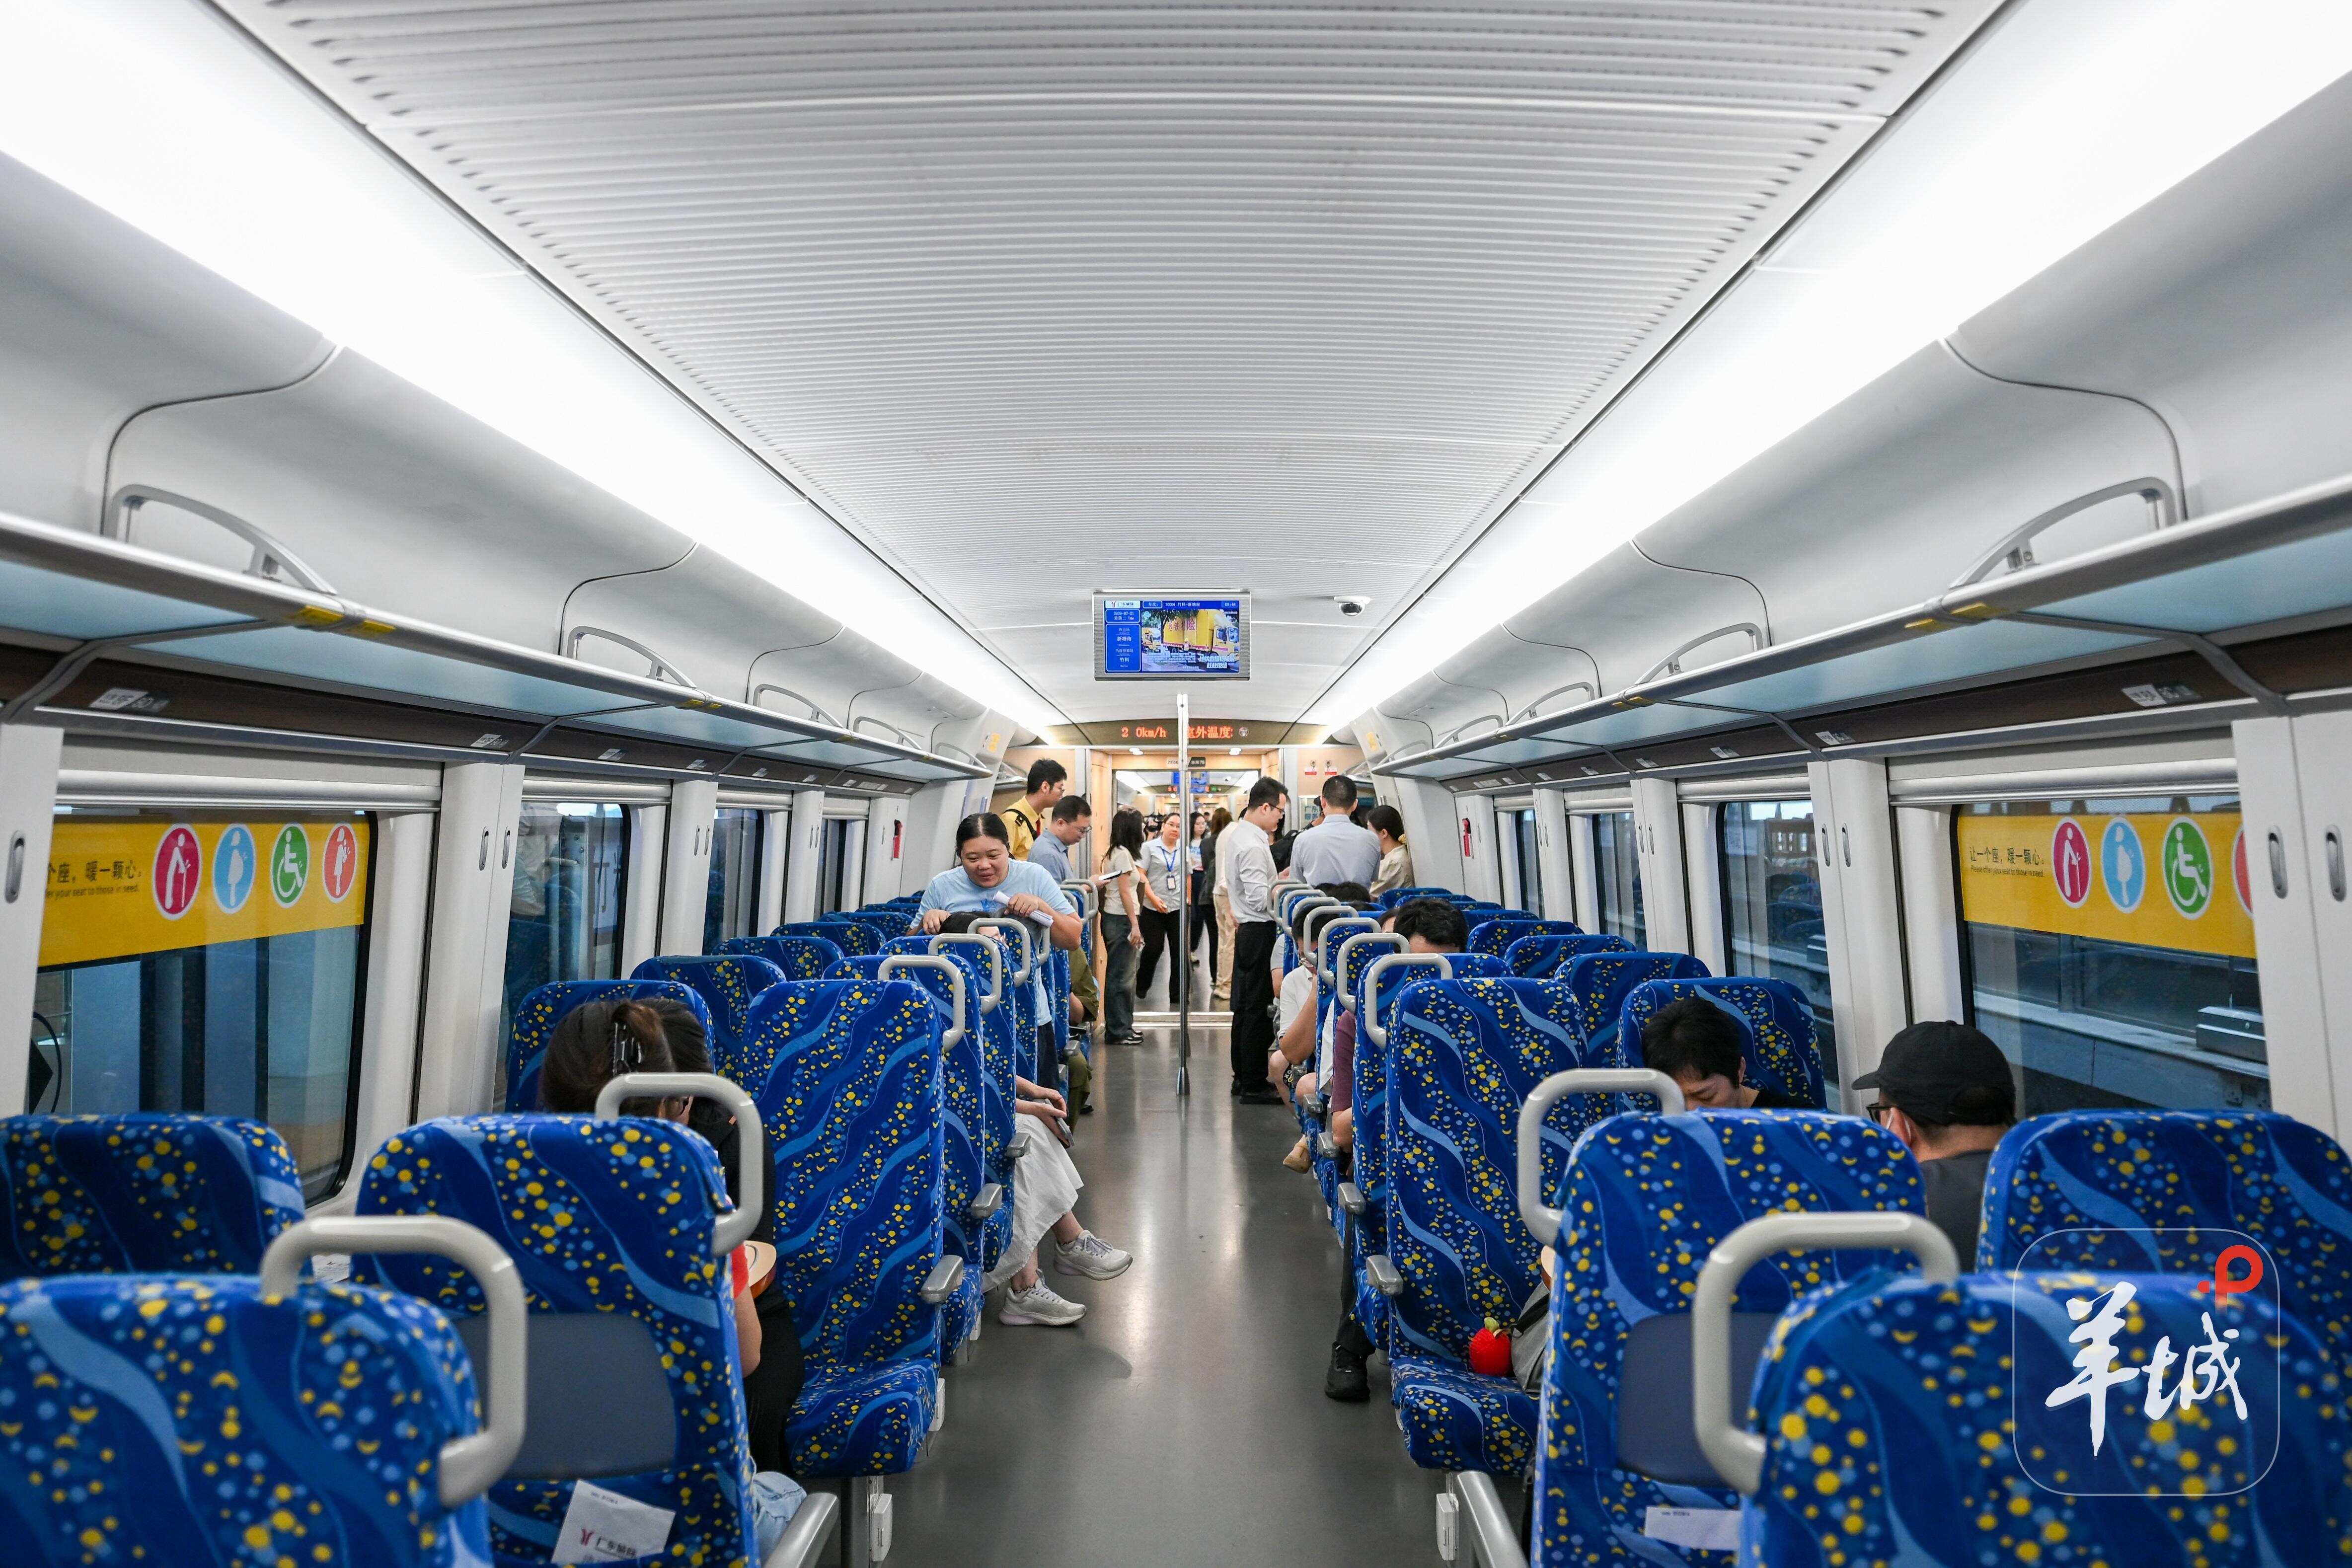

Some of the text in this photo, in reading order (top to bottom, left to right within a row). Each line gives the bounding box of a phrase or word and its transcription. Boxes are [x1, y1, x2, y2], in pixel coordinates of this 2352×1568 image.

[1122, 727, 1129, 738] 2
[1136, 726, 1167, 738] 0km/h
[1971, 865, 1982, 873] Please
